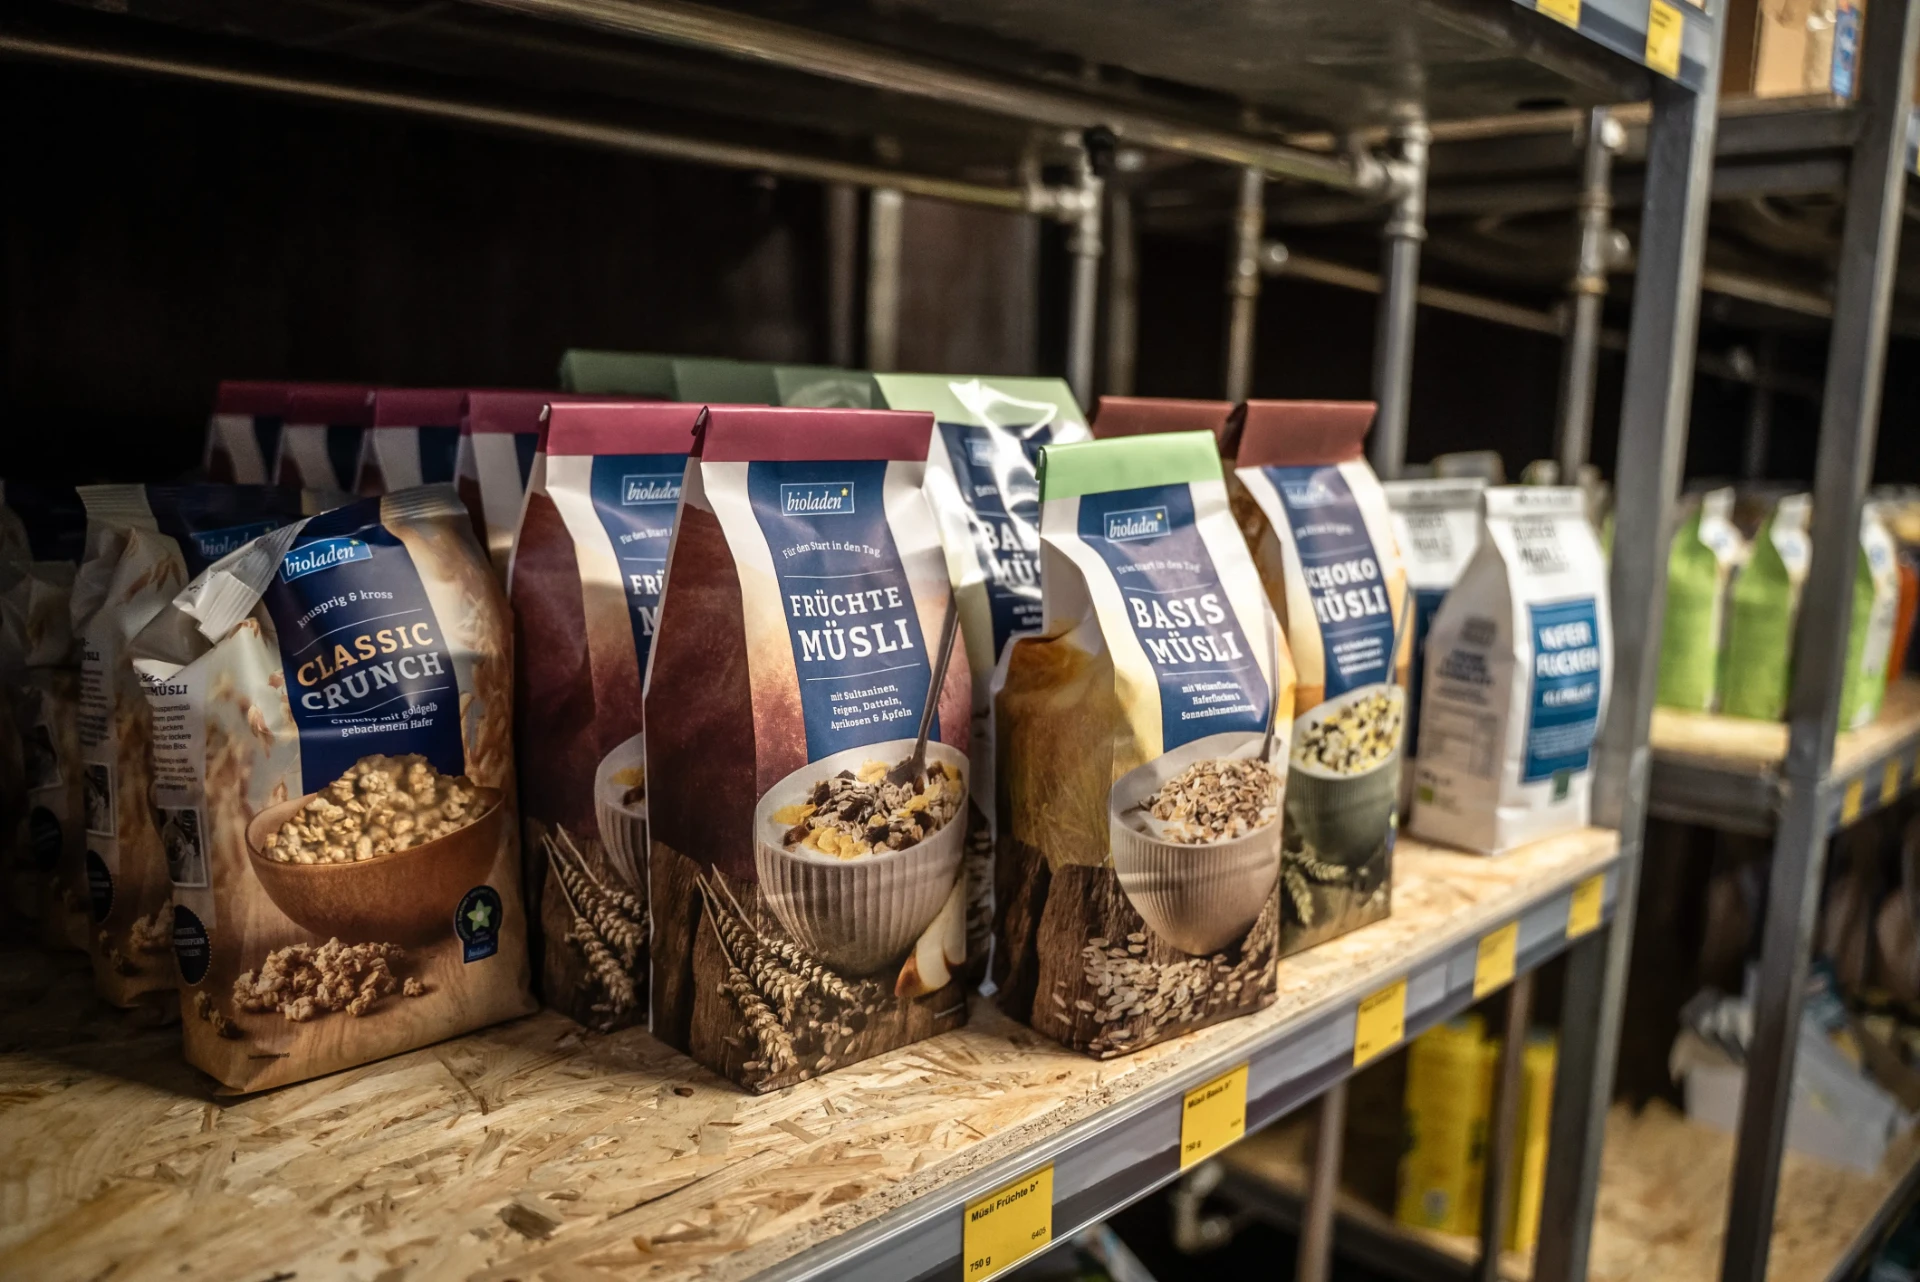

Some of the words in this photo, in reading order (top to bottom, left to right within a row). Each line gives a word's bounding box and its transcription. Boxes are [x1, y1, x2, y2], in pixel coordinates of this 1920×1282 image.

[787, 490, 842, 512] bioladen
[1109, 516, 1159, 538] bioladen
[284, 543, 355, 577] bioladen
[782, 547, 796, 559] Für
[796, 543, 811, 553] den
[810, 541, 830, 551] Start
[832, 540, 842, 550] in
[843, 541, 861, 553] den
[862, 545, 881, 558] Tag
[297, 595, 348, 629] knusprig
[349, 592, 357, 601] &
[360, 590, 393, 600] kross
[790, 586, 903, 617] FRÜCHTE
[1129, 593, 1225, 629] BASIS
[797, 618, 914, 662] MÜSLI
[1145, 630, 1243, 664] MÜSLI
[297, 622, 434, 687] CLASSIC
[301, 652, 445, 710] CRUNCH
[1182, 683, 1195, 693] mit
[830, 692, 843, 702] mit
[844, 684, 899, 700] Sultaninen,
[1192, 693, 1235, 705] Haferflocken
[331, 717, 377, 725] Crunchy
[380, 713, 400, 721] mit
[402, 702, 438, 719] goldgelb
[832, 705, 862, 716] Feigen,
[863, 696, 903, 711] Datteln,
[341, 721, 409, 738] gebackenem
[410, 717, 434, 729] Hafer
[830, 717, 871, 731] Aprikosen
[873, 714, 879, 722] &
[882, 707, 912, 722] Äpfeln
[971, 1203, 995, 1223] Müsli
[996, 1187, 1029, 1210] Früchte
[1031, 1226, 1047, 1239] 6405
[969, 1259, 984, 1273] 750
[985, 1256, 991, 1266] g
